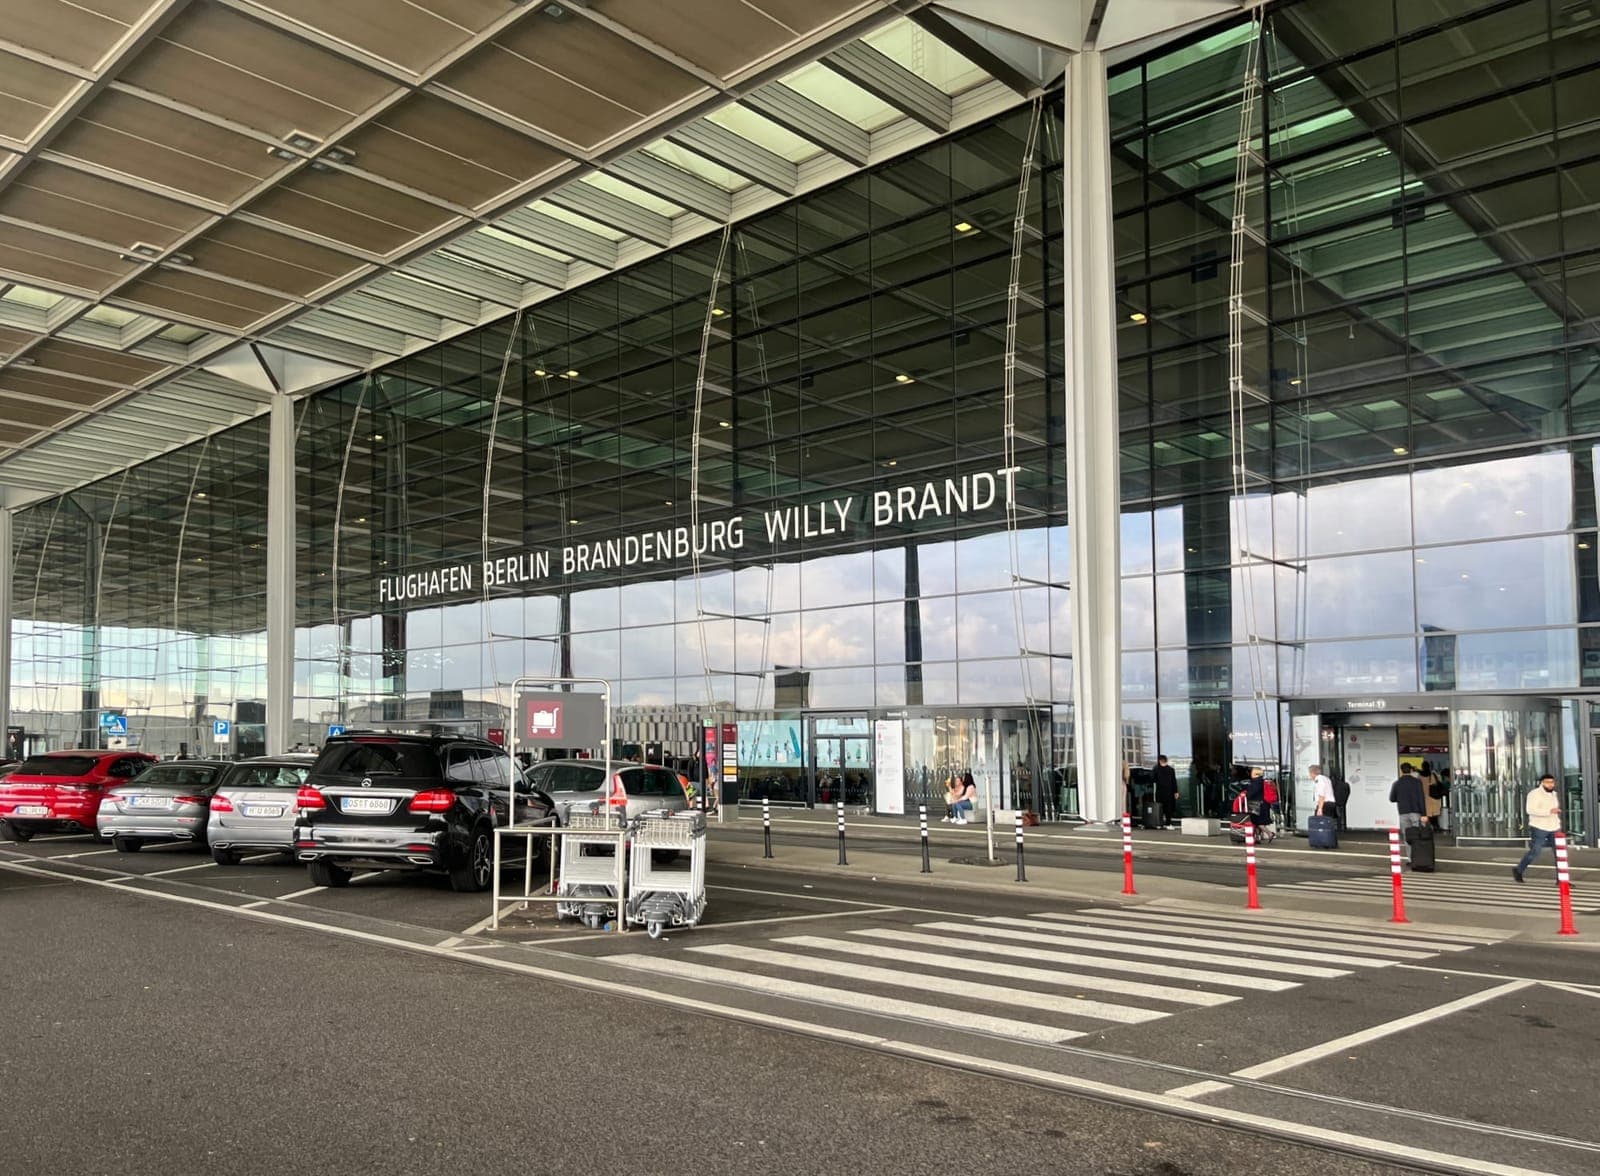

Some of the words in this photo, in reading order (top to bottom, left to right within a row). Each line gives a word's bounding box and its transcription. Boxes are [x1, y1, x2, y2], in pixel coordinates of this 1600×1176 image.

[379, 564, 472, 603] FLUGHAFEN
[483, 551, 549, 586] BERLIN
[563, 516, 744, 575] BRANDENBURG
[764, 497, 853, 543] WILLY
[874, 466, 1021, 527] BRANDT
